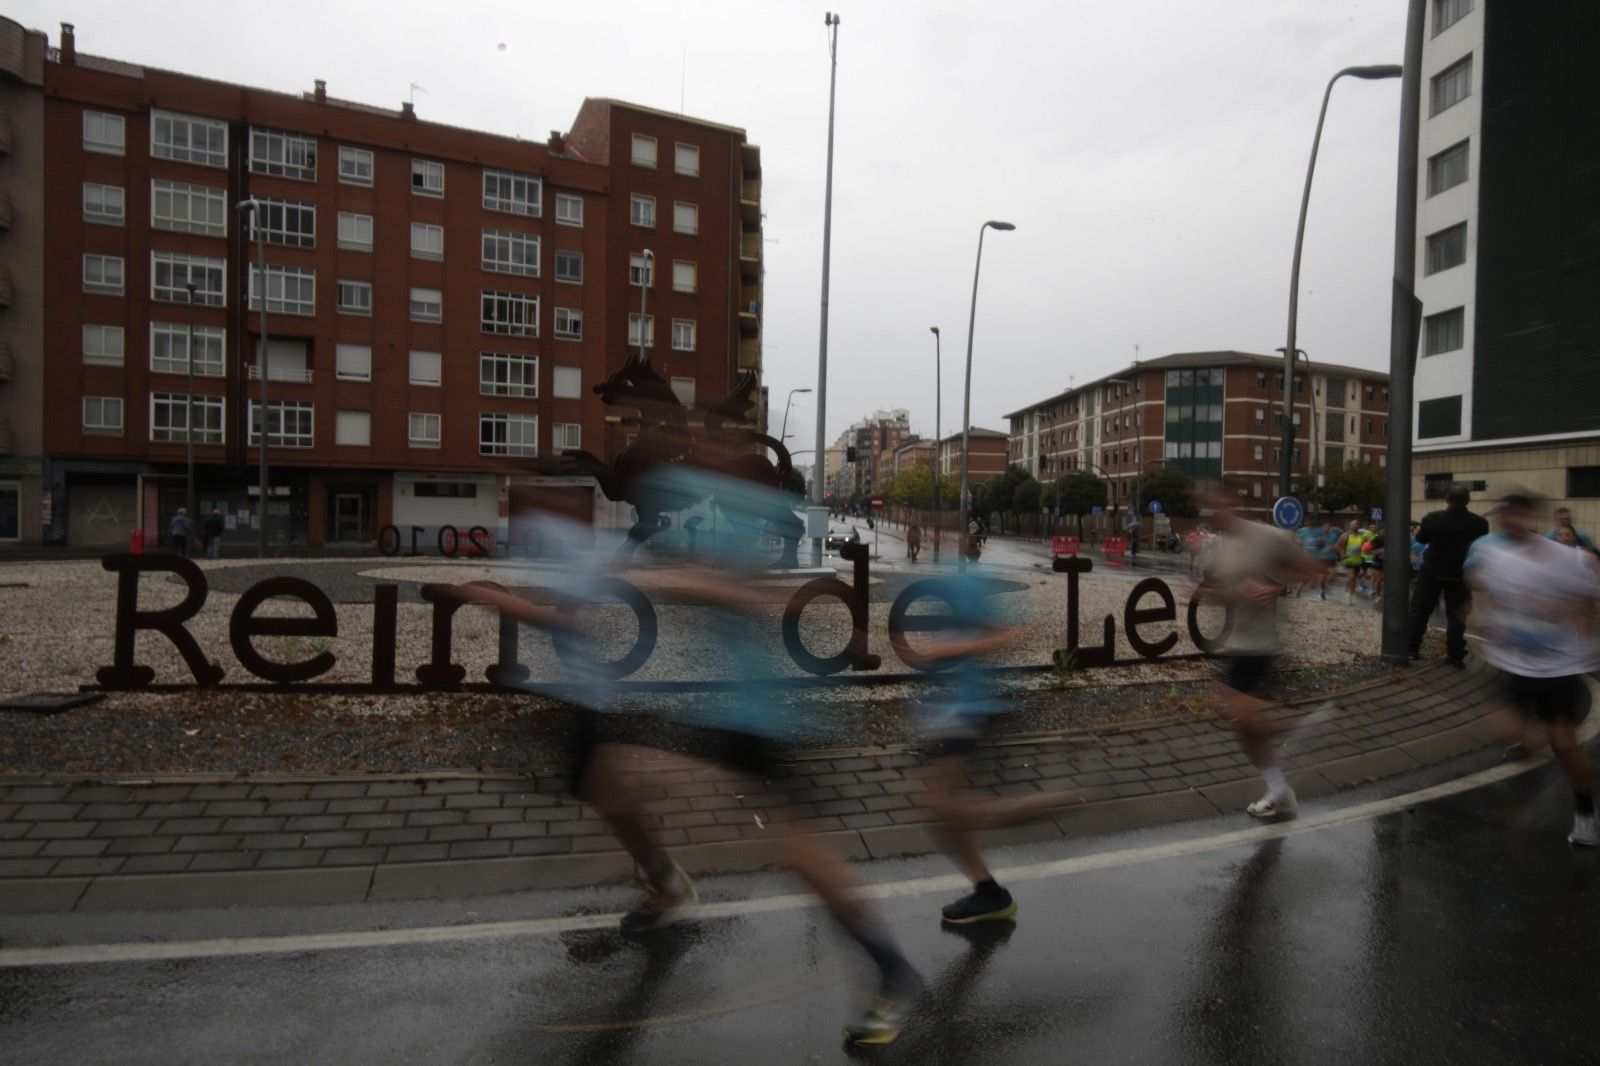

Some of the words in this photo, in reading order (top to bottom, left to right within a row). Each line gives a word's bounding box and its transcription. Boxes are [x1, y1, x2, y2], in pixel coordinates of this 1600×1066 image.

[97, 554, 657, 690] Reino
[782, 543, 980, 677] de
[1054, 557, 1240, 668] Leo
